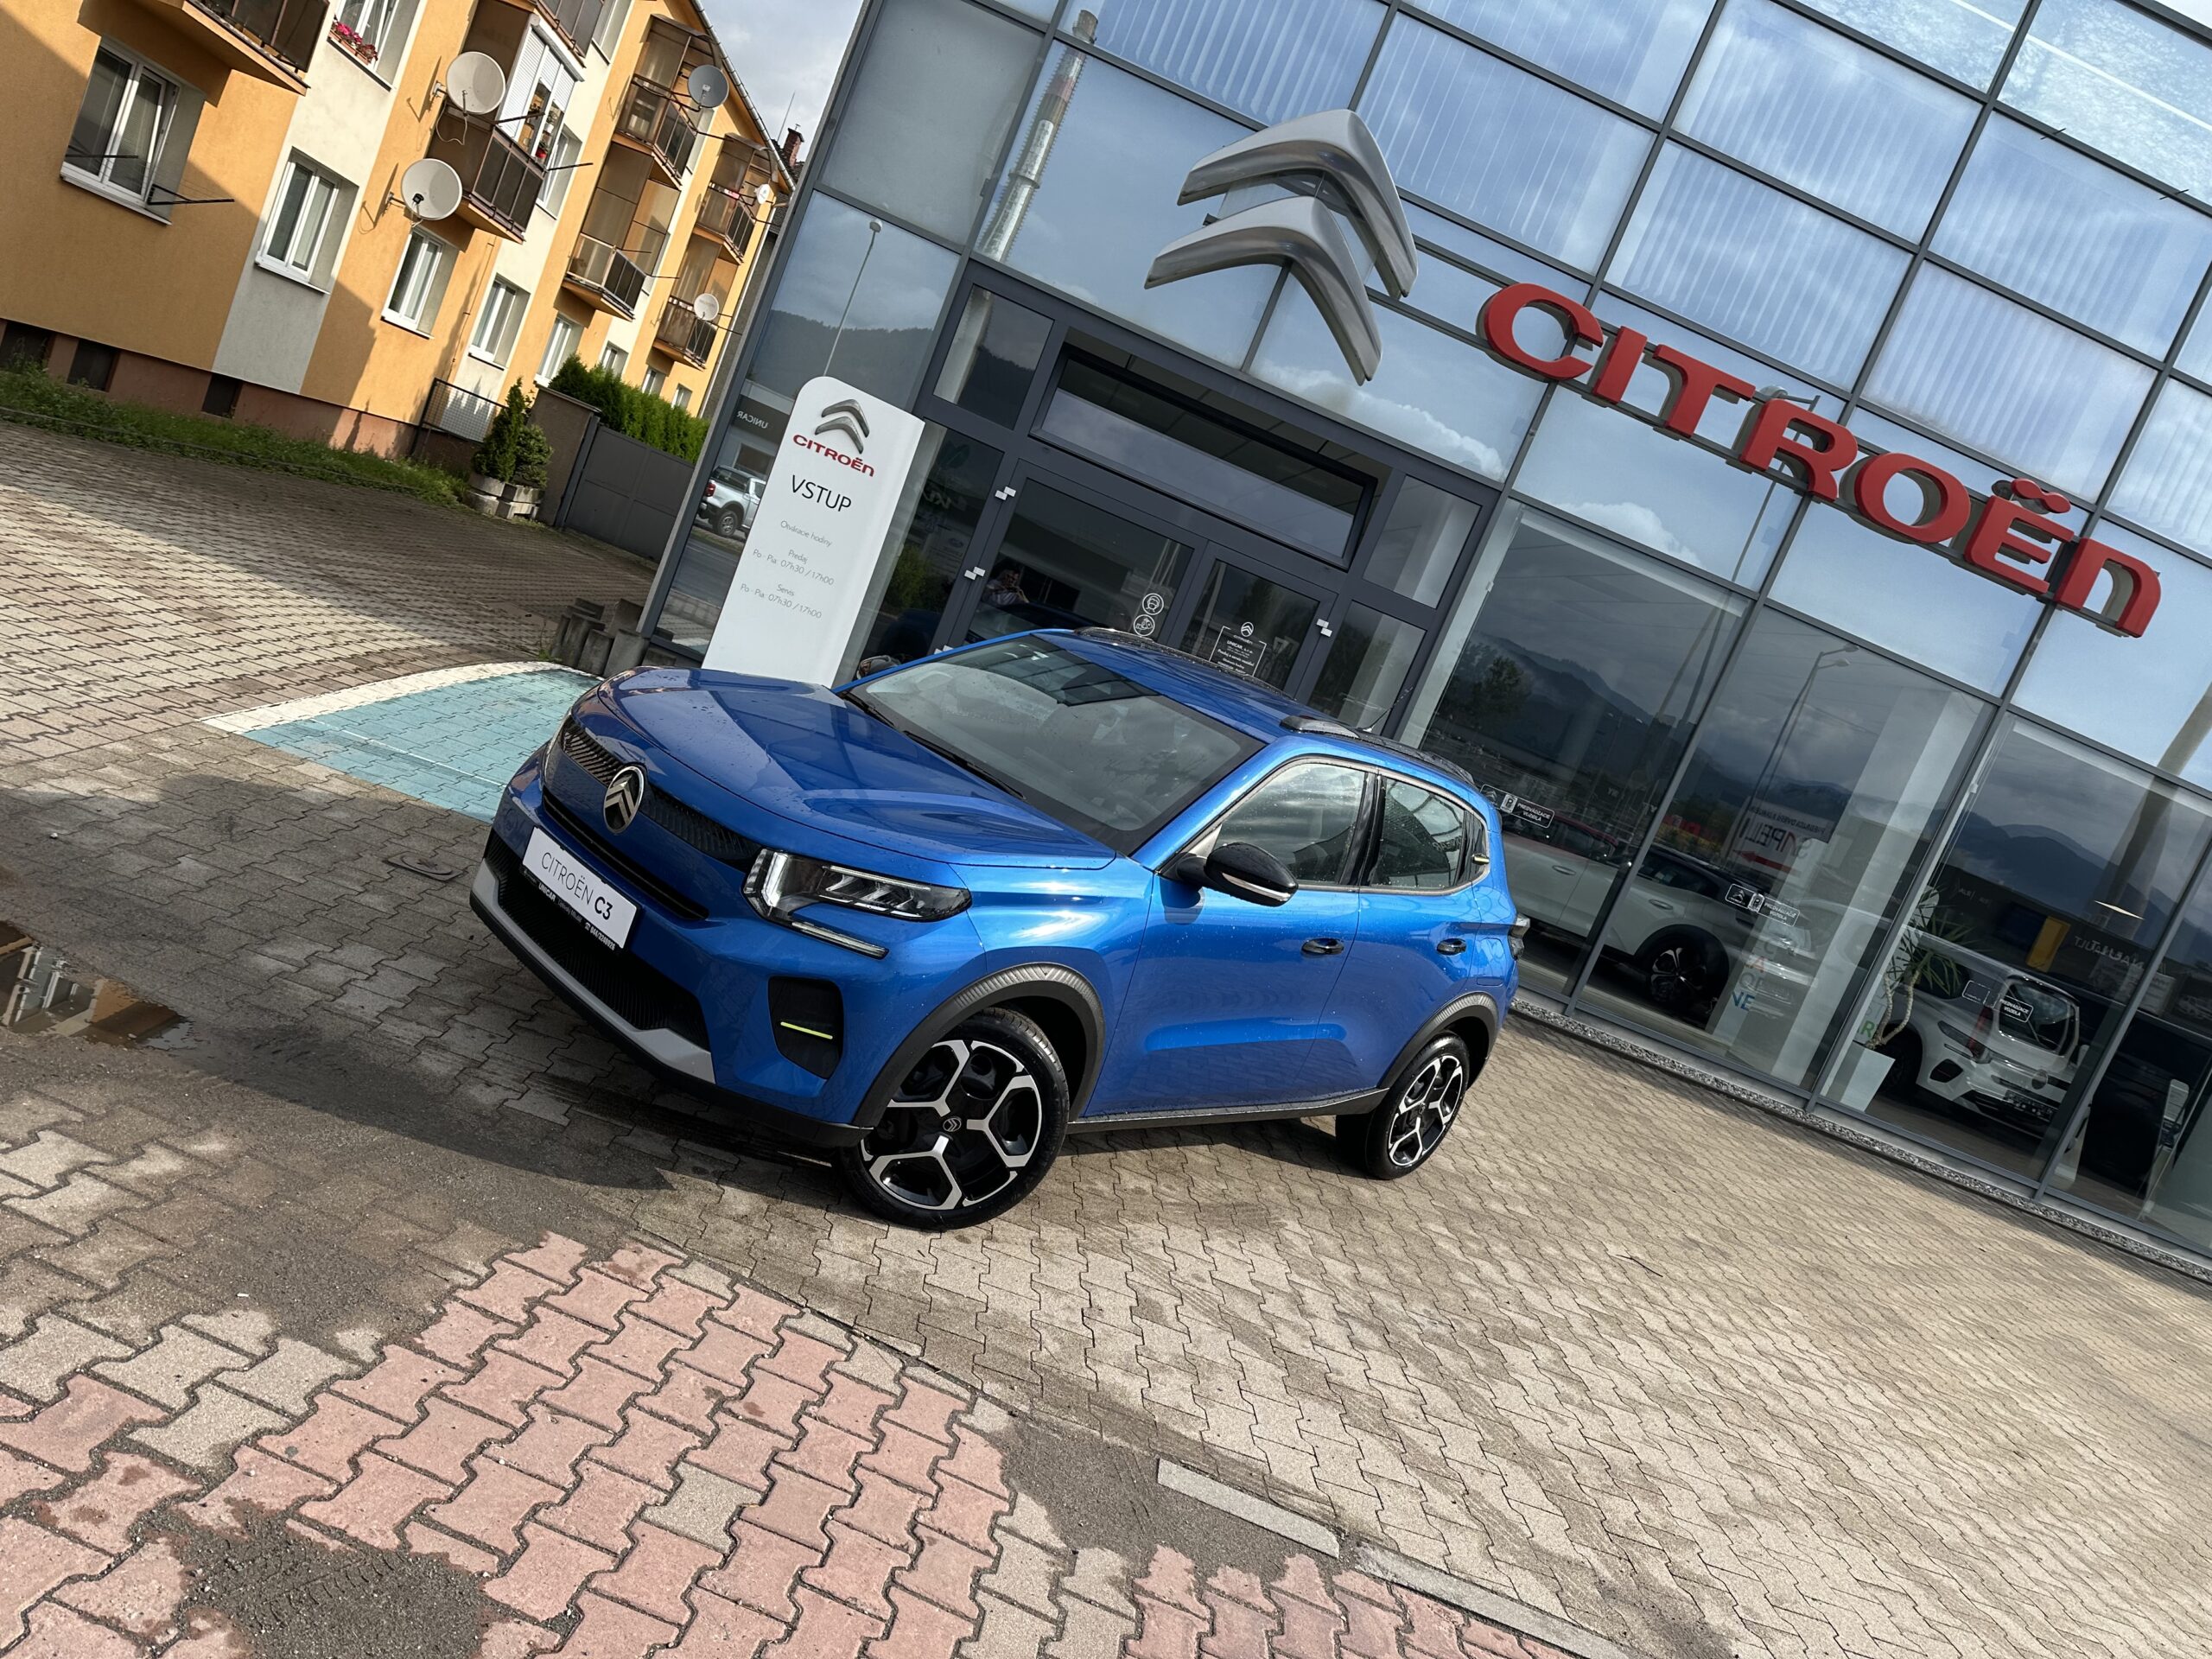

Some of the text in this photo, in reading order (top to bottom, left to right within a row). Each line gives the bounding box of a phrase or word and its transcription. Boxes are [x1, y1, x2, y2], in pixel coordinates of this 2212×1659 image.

[792, 434, 875, 477] CITROËN
[1479, 283, 2162, 638] CITROËN
[791, 474, 852, 512] VSTUP
[788, 549, 808, 565] Predaj
[810, 532, 833, 548] hodiny
[753, 549, 762, 558] Po
[780, 559, 804, 575] 07h30
[812, 571, 835, 586] 17h00
[741, 583, 749, 593] Po
[768, 594, 792, 608] 07h30
[800, 605, 823, 619] 17h00
[777, 583, 795, 597] Servis
[538, 882, 556, 902] UNICAR
[541, 852, 594, 906] CITROËN
[594, 896, 613, 920] C3
